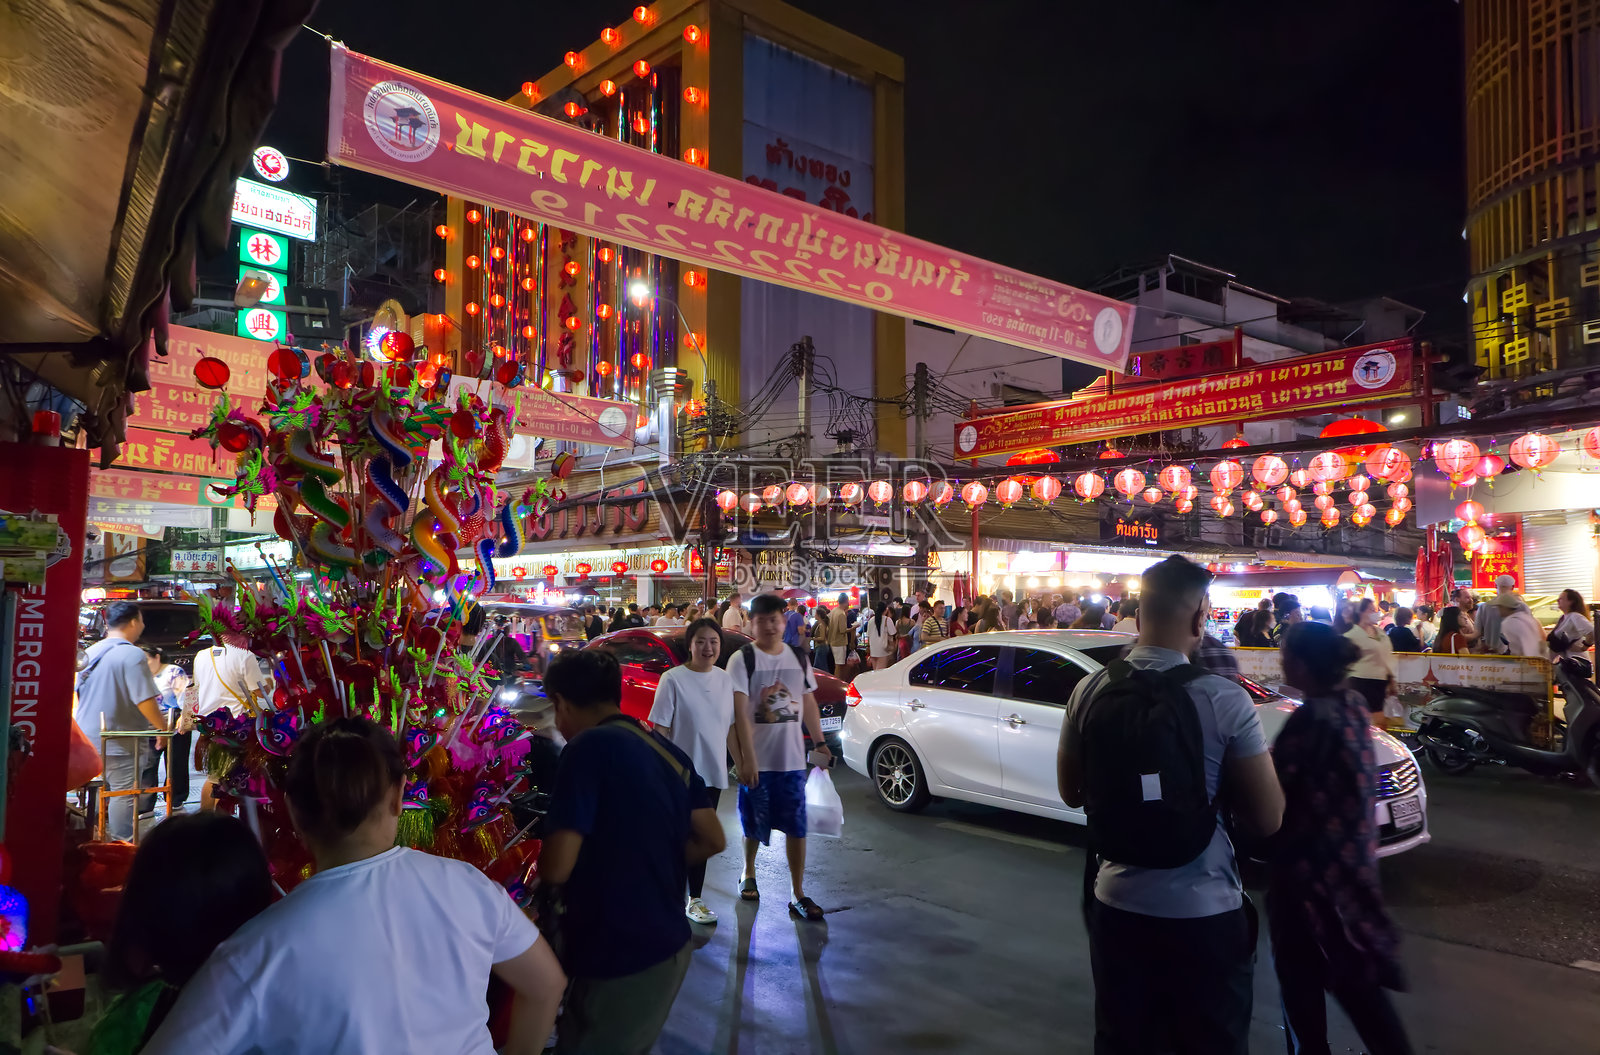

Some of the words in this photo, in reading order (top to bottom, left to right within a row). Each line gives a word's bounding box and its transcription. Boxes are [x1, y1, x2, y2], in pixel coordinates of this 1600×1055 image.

[1270, 356, 1346, 383] เยาวราช
[1271, 378, 1348, 405] เยาวราช
[1115, 518, 1159, 540] ต้นตำรับ
[1438, 663, 1474, 673] YAOWARAJ
[1479, 665, 1505, 673] STREET
